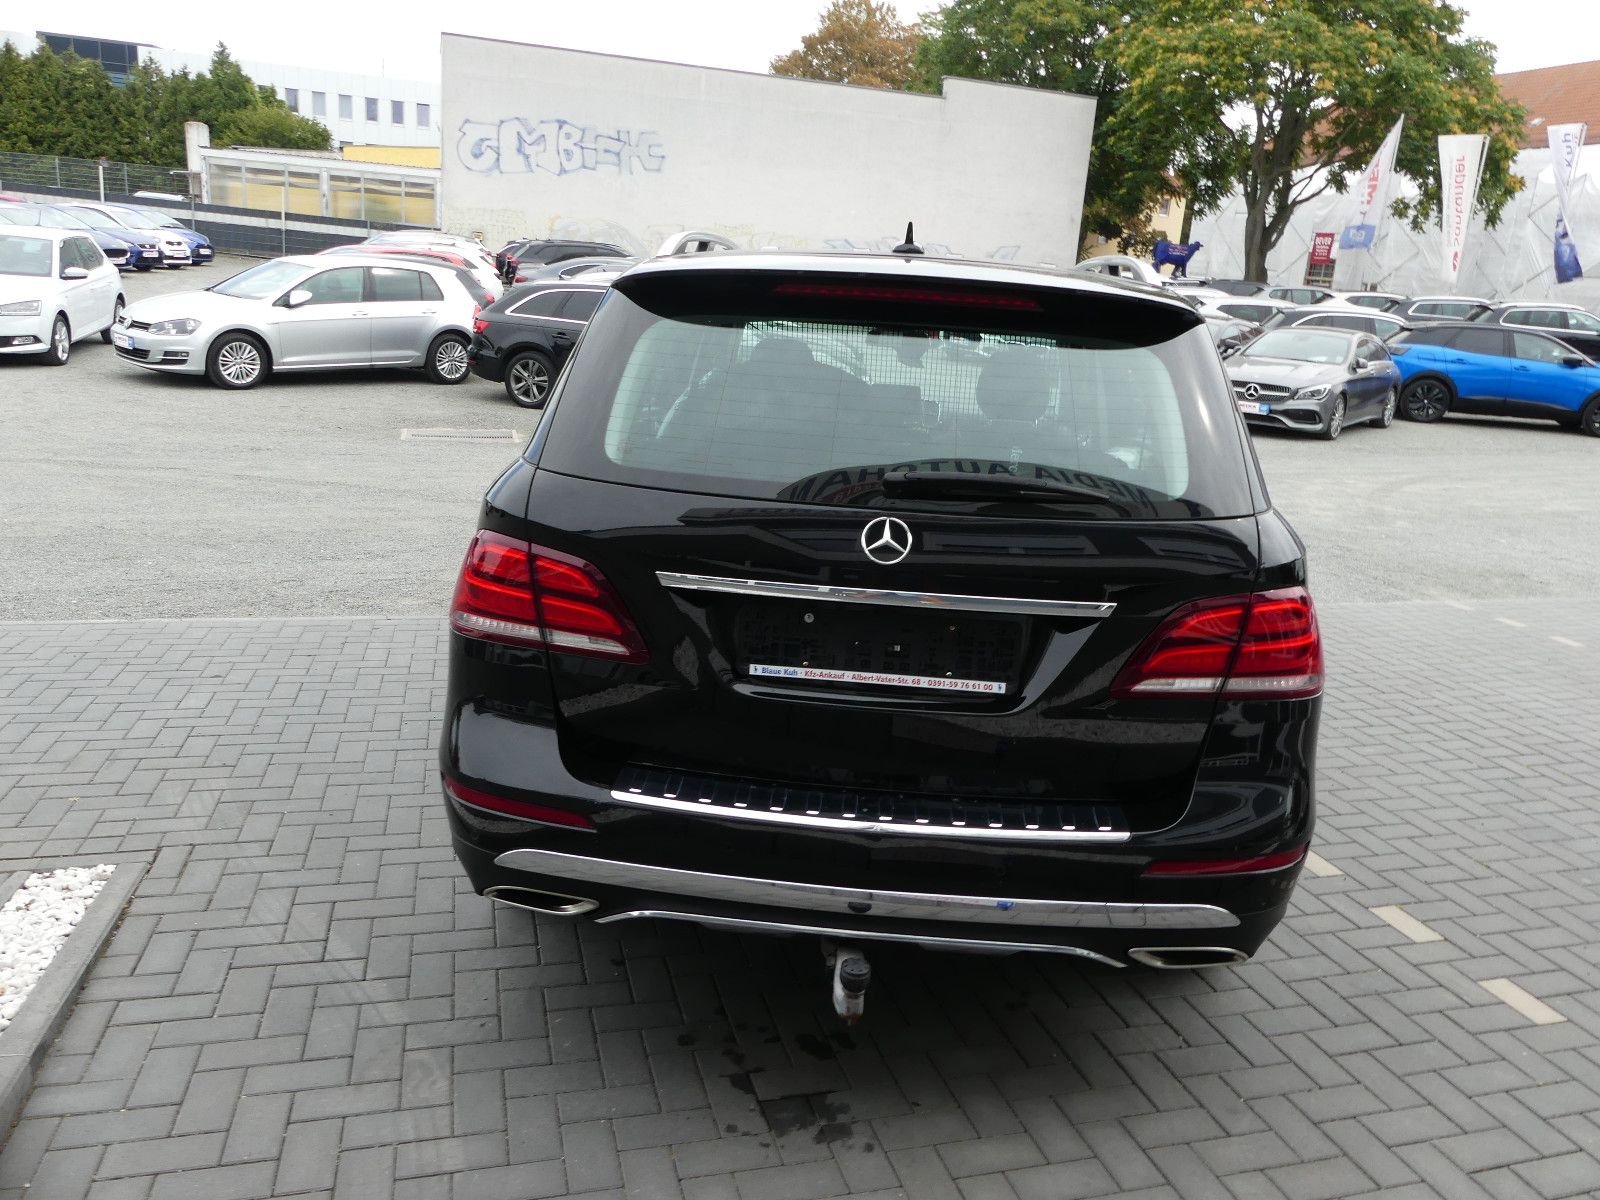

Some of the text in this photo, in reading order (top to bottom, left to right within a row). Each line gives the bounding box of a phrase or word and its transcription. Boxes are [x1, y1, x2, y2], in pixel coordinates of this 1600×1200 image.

[761, 667, 993, 692] Blaue Kuh Kfz-Ankauf Albert-Vater-Str. 68 0391-59 76 61 00
